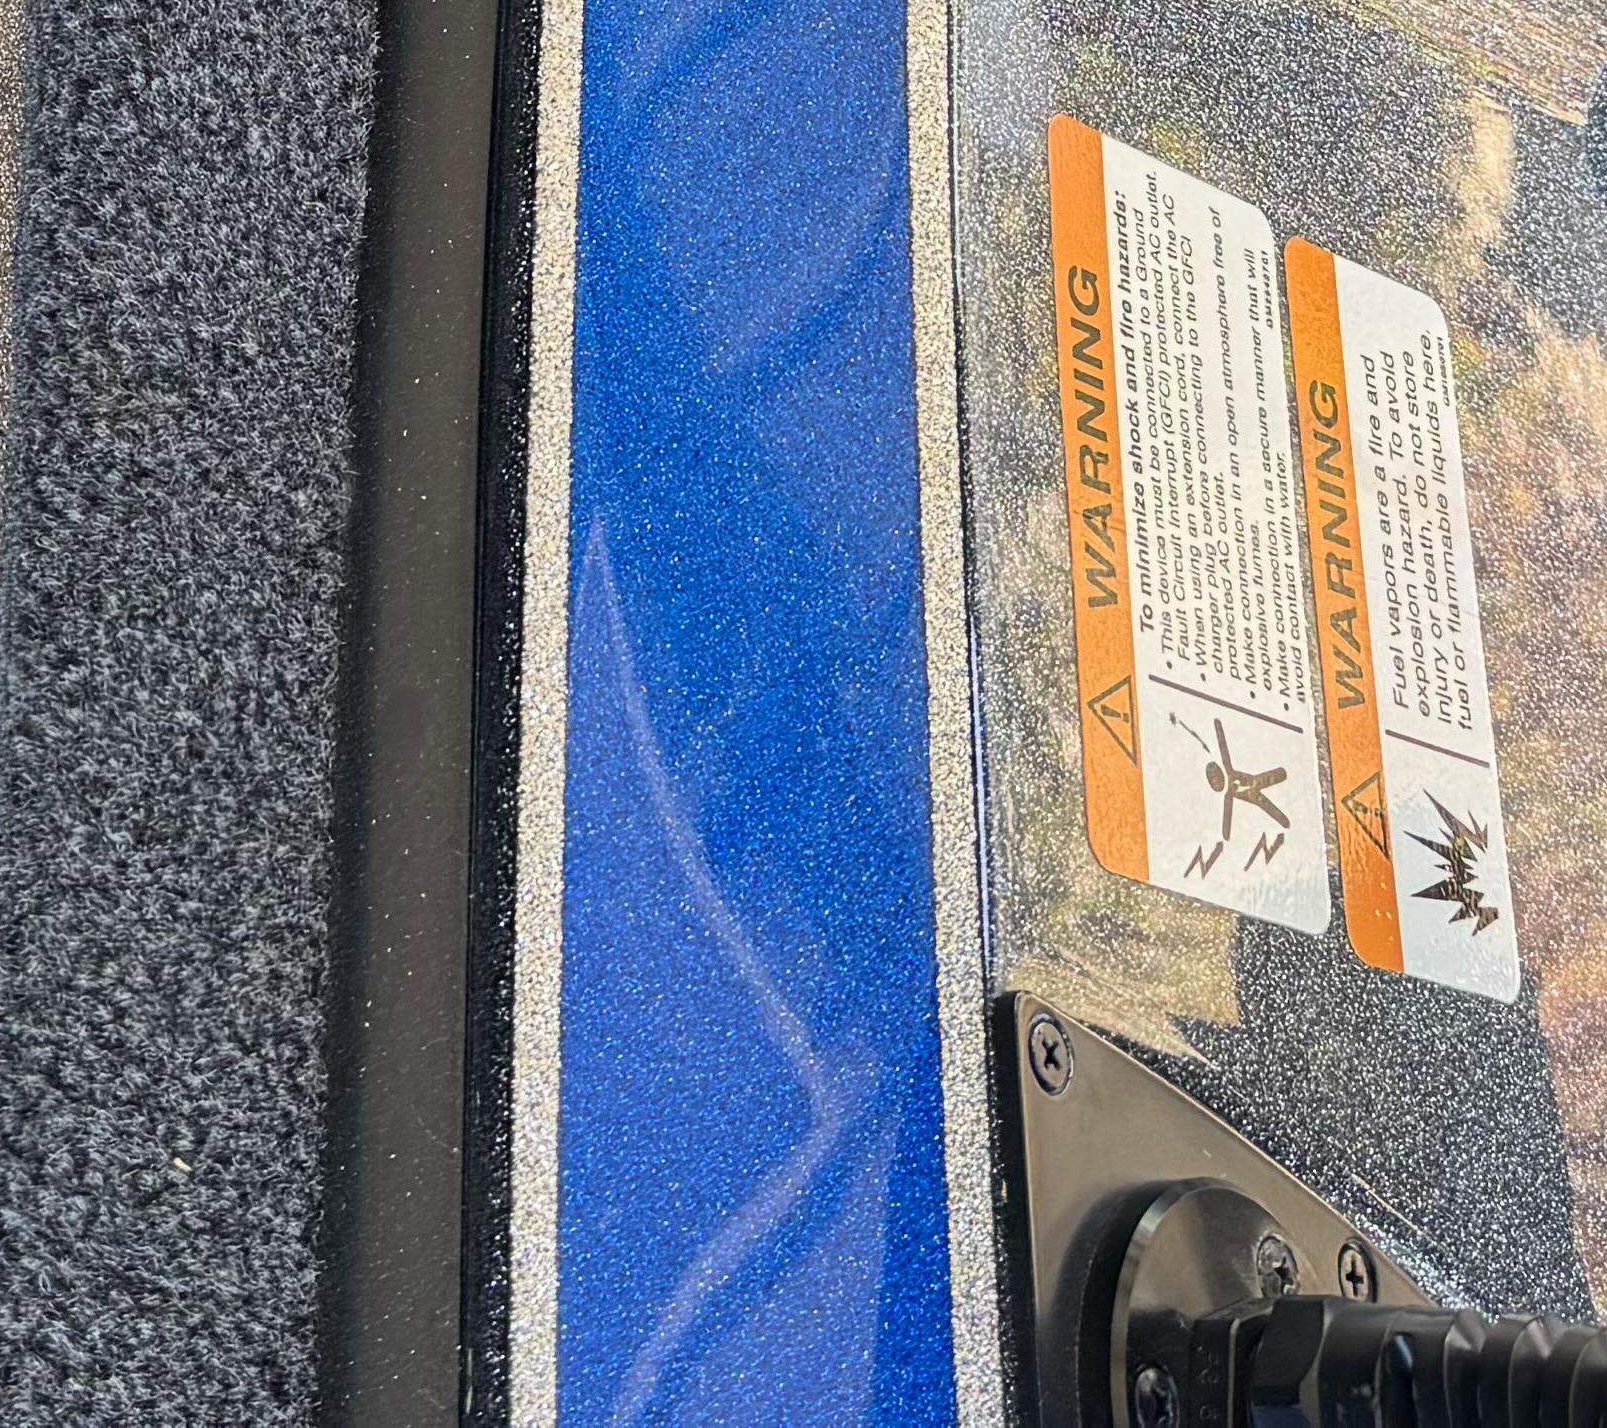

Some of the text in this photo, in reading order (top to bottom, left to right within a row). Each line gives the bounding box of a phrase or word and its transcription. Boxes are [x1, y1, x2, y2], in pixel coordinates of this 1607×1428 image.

[1132, 207, 1147, 281] Ground
[1244, 247, 1255, 278] will
[1246, 283, 1259, 321] that
[1139, 305, 1150, 325] to
[1140, 331, 1158, 438] connected
[1251, 326, 1265, 401] manner
[1068, 267, 1116, 606] WARNING
[1113, 190, 1154, 632] To minimize shock and fire hazards:
[1145, 171, 1190, 660] Fault Circuit Interrupt (GFCI) protected AC outlet.
[1148, 444, 1160, 471] be
[1162, 193, 1207, 666] When using an extension cord, connect the AC
[1180, 234, 1223, 673] charger plug before connecting to the GFCI
[1208, 205, 1256, 684] Make connection in an open atmosphere free of
[1257, 406, 1271, 473] secure
[1151, 475, 1164, 529] must
[1156, 535, 1170, 604] device
[1264, 496, 1275, 514] in
[1309, 381, 1364, 707] WARNING
[1360, 354, 1409, 709] Fuel vapors are a fire and
[1379, 350, 1430, 716] explosion hazard. To avoid
[1402, 350, 1452, 724] injury or death, do not store
[1420, 329, 1472, 730] fuel or flammable liquids here.
[1160, 610, 1173, 653] This
[1213, 471, 1241, 680] protected AC outlet.
[1249, 521, 1272, 690] explosive fumes.
[1266, 520, 1284, 633] connection
[1275, 452, 1305, 702] avoid contact with water.
[1276, 639, 1289, 696] Make
